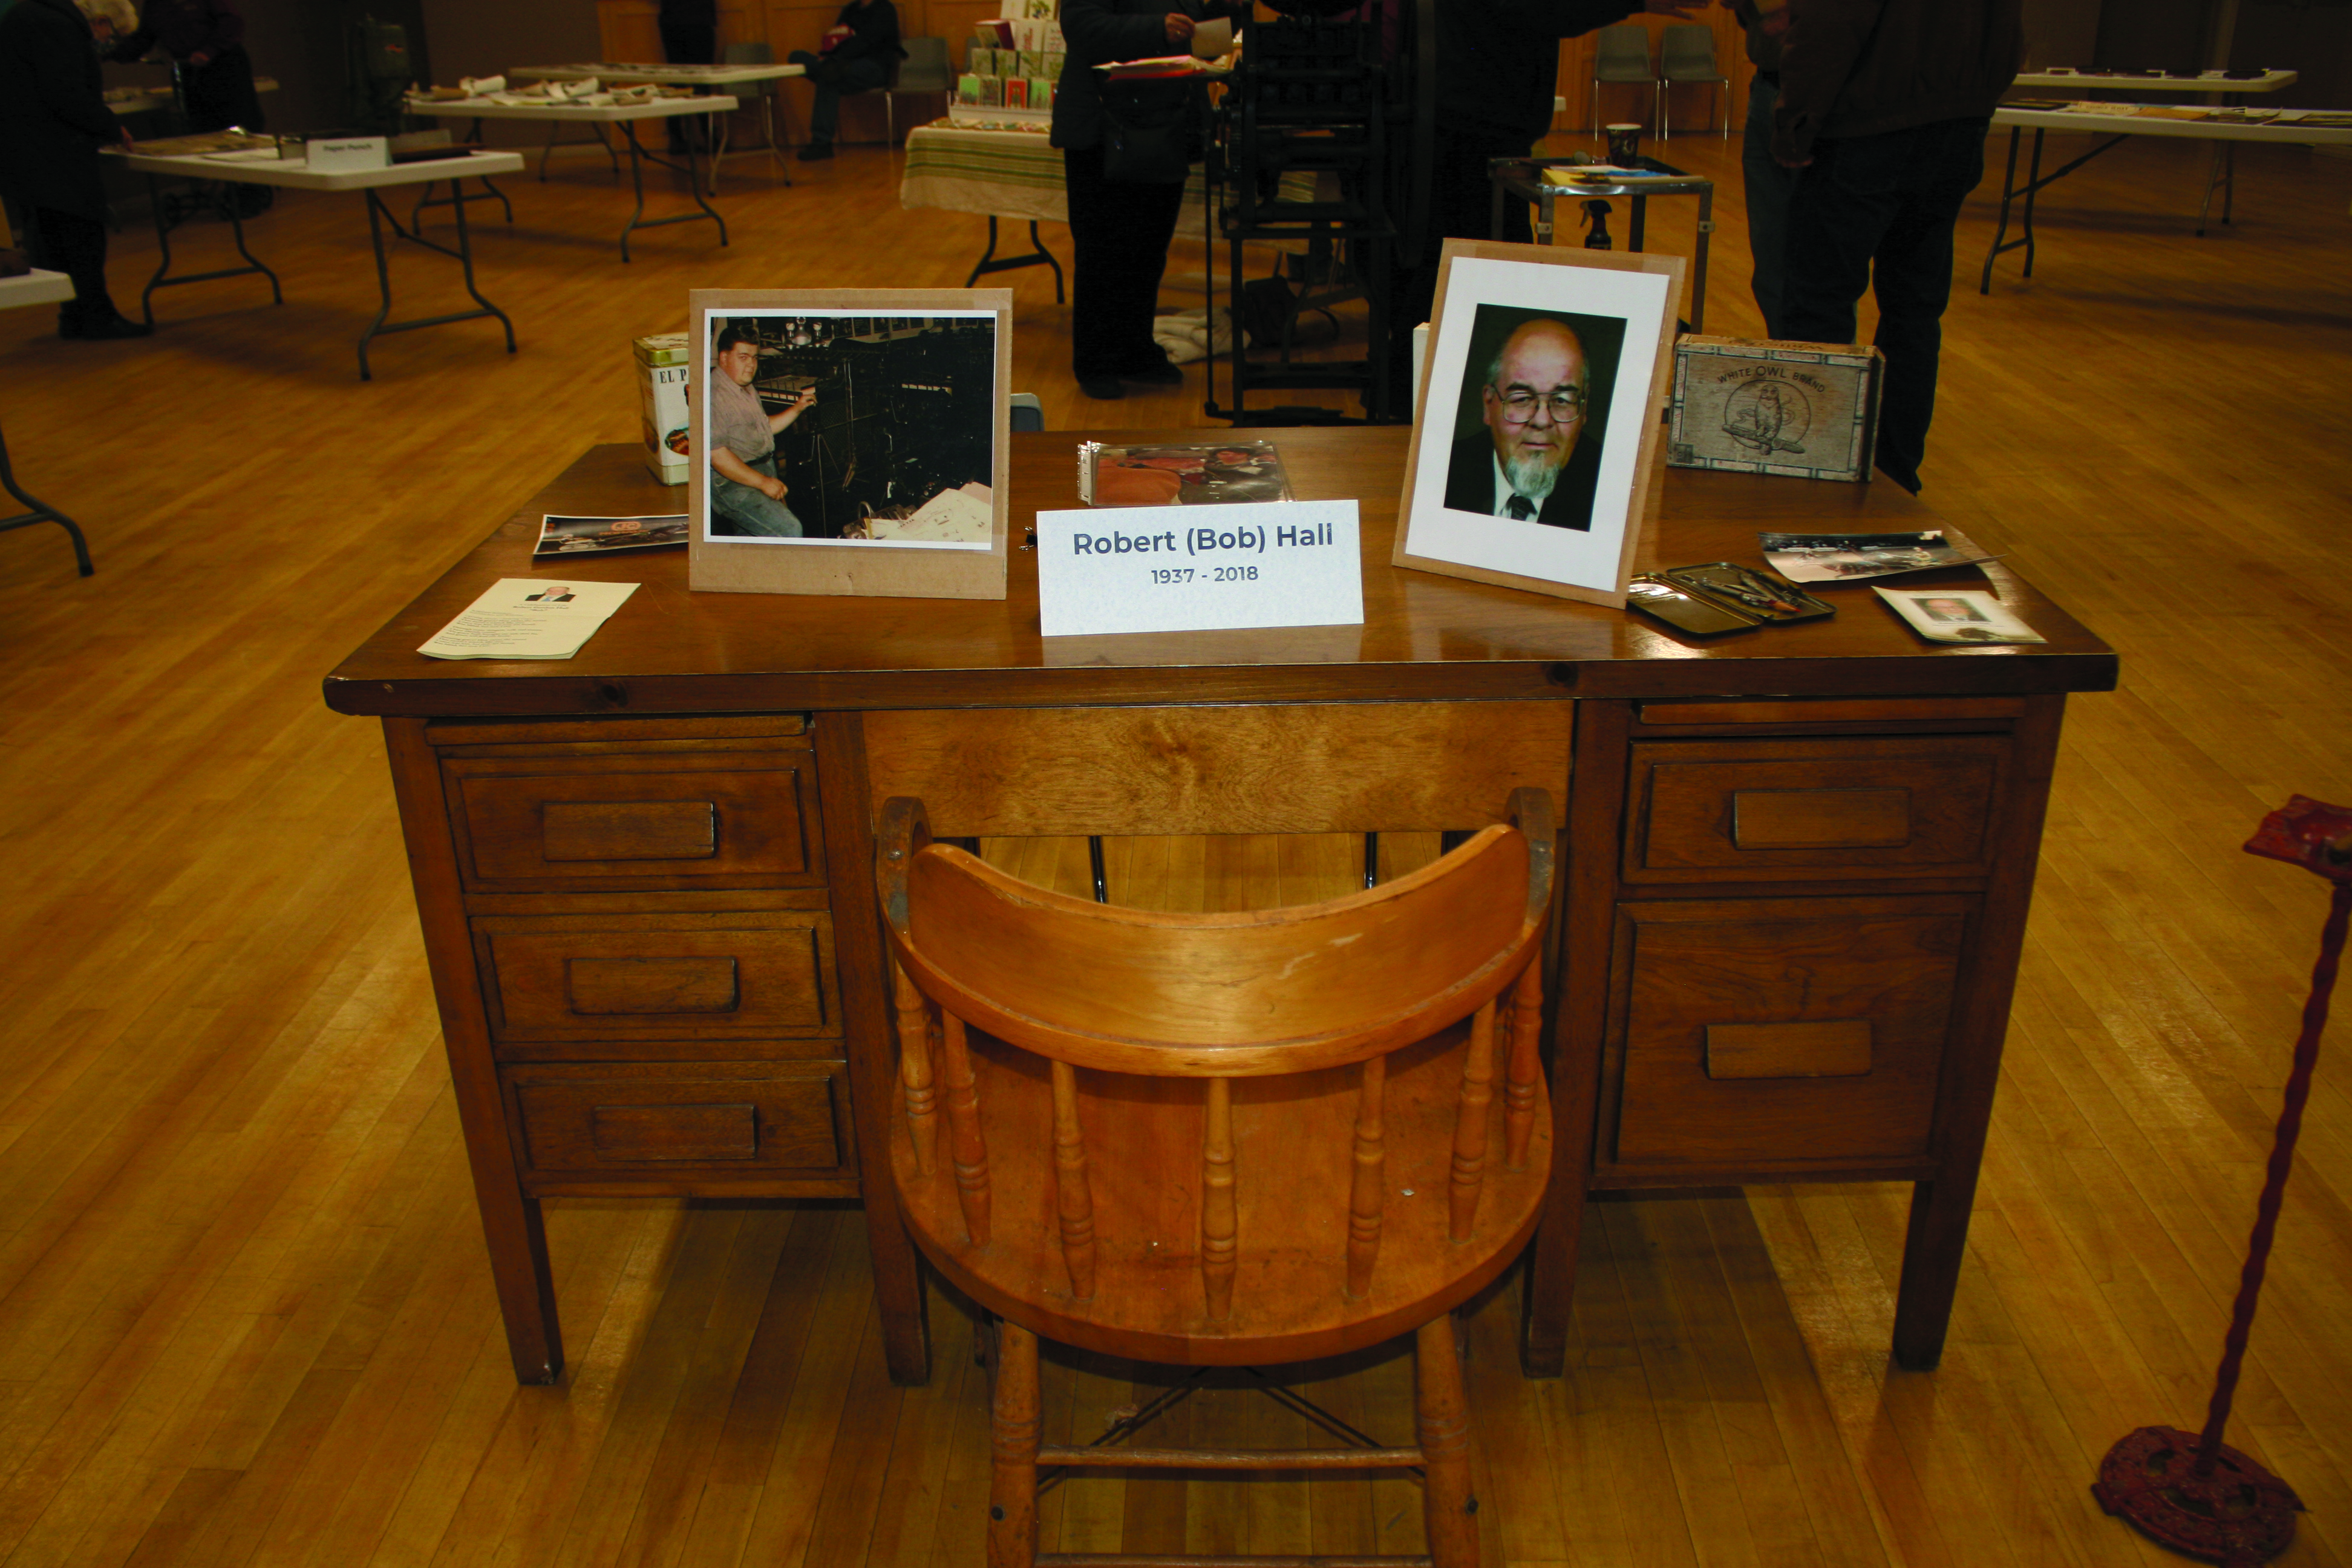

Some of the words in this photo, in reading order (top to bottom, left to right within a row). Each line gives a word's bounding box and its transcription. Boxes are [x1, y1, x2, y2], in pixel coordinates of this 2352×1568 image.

[659, 370, 675, 384] EL
[679, 368, 688, 382] P
[1717, 367, 1752, 384] WHITE
[1756, 365, 1786, 378] OWL
[1792, 371, 1826, 393] BRAND
[1073, 531, 1177, 555] Robert
[1186, 525, 1266, 556] (Bob)
[1276, 523, 1333, 547] Hall
[1151, 569, 1195, 584] 1937
[1214, 566, 1259, 582] 2018
